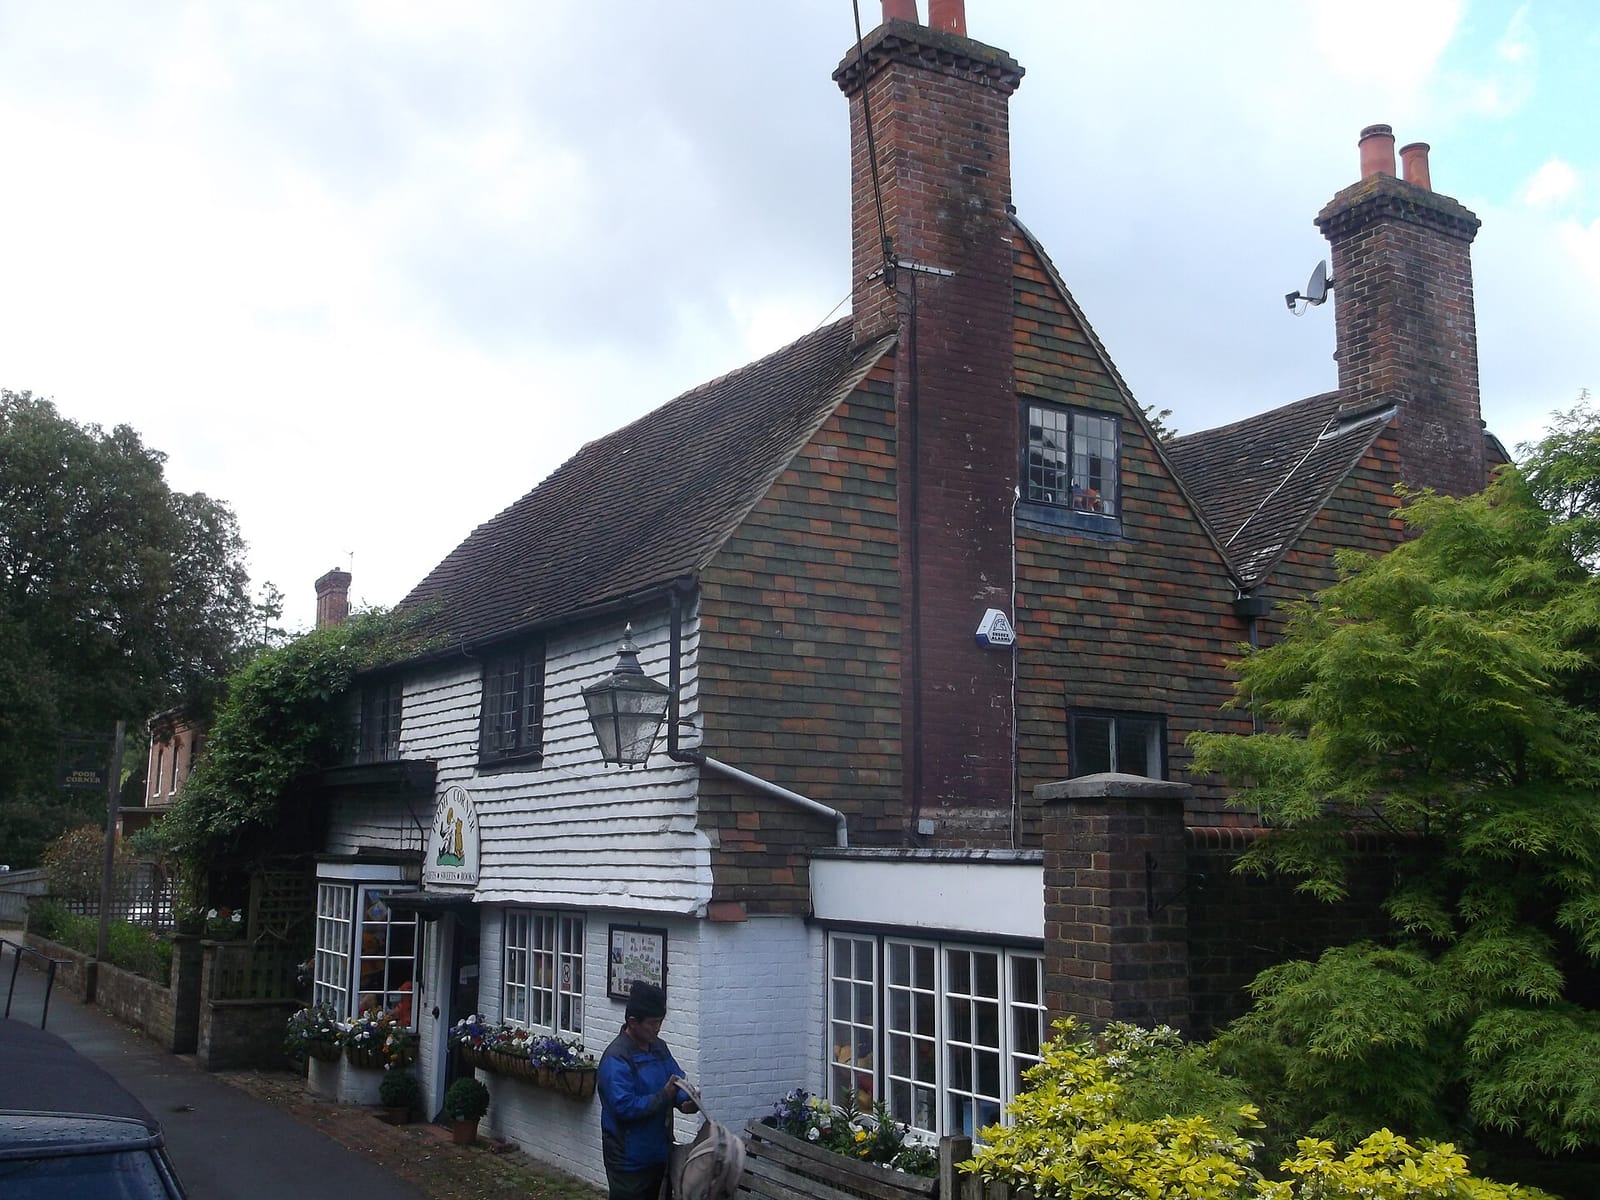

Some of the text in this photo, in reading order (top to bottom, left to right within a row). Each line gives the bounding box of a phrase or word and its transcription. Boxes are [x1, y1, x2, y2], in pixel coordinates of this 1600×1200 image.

[65, 776, 101, 784] CORNER
[432, 788, 475, 834] POOH CORNER
